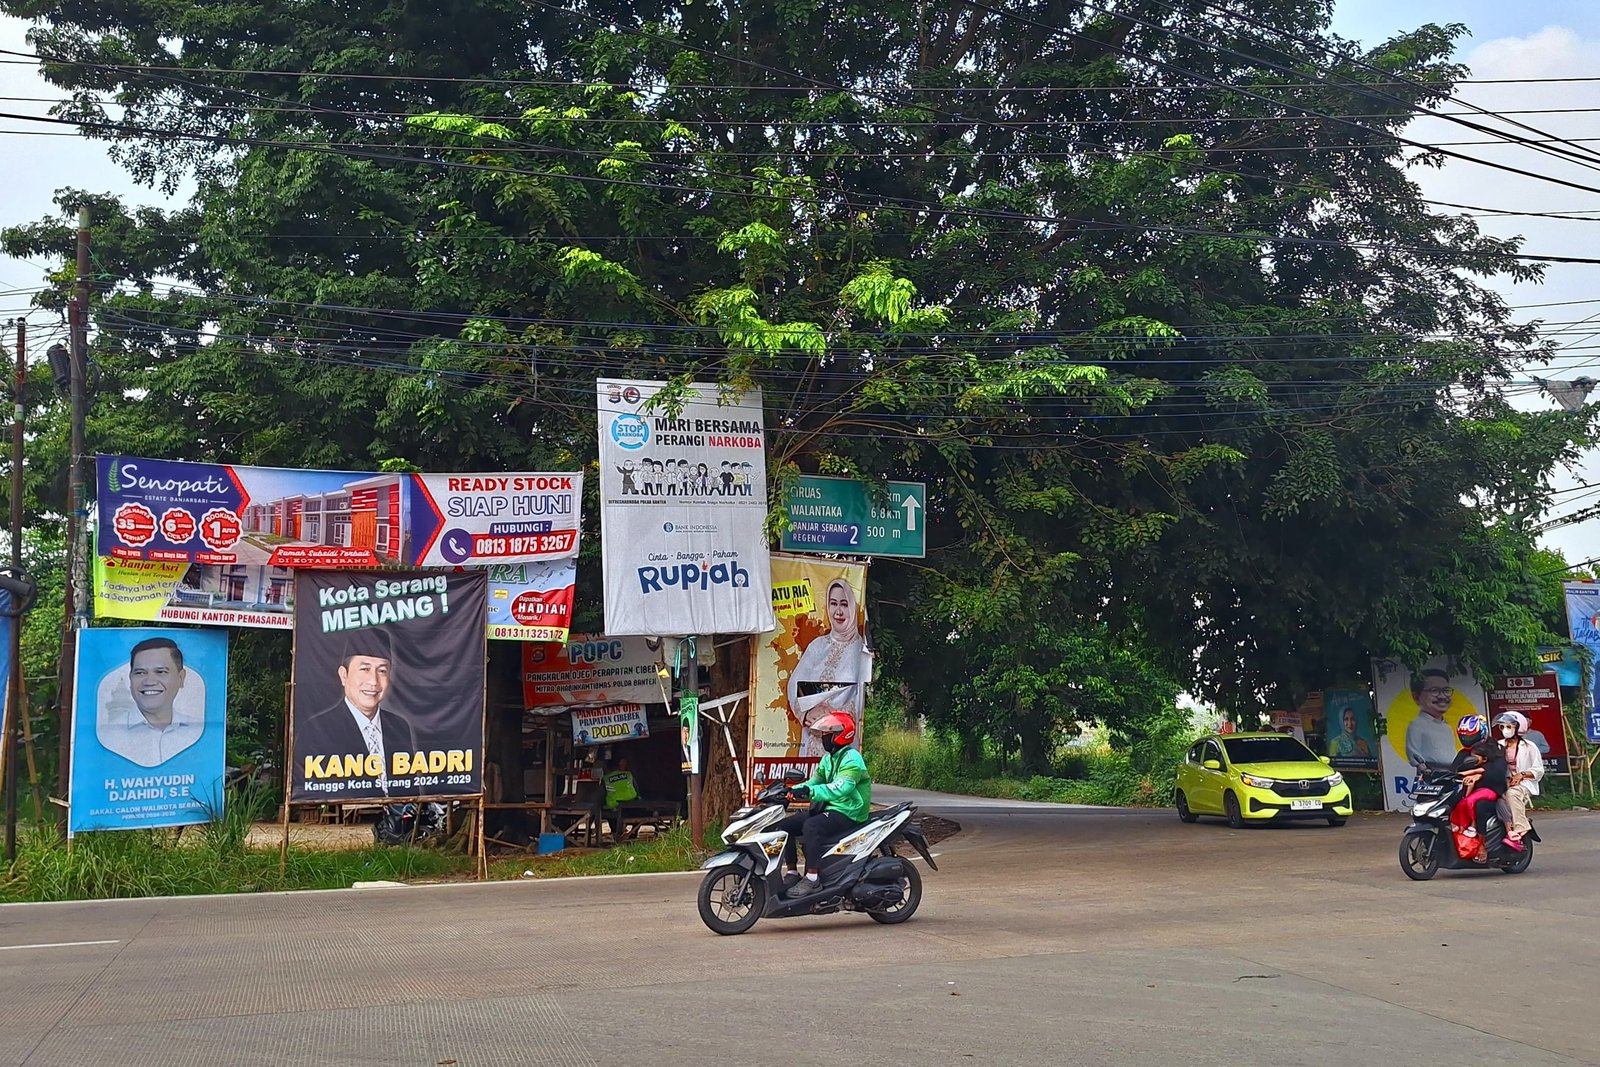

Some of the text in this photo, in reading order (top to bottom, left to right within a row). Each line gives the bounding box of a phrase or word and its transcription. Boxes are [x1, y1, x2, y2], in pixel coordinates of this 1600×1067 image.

[617, 424, 642, 433] STOP
[655, 418, 760, 434] MARI BERSAMA
[656, 435, 762, 448] PERANGI NARKOBA
[121, 464, 229, 496] Senopati
[448, 477, 572, 492] READY STOCK
[448, 494, 572, 517] SIAP HUNI
[791, 505, 842, 517] WALANTAKA
[118, 519, 135, 530] 35
[165, 520, 177, 532] 6
[206, 513, 236, 524] BOOKING
[210, 521, 221, 538] 1
[494, 523, 543, 534] HUBUNGI
[792, 522, 900, 544] BANJAR SERANG 2 500 m
[476, 534, 570, 554] 0813 1875 3267
[793, 533, 826, 543] REGENCY
[648, 550, 738, 562] Cinta Bangga Paham
[120, 560, 180, 572] Banjar Asri
[637, 560, 749, 594] Rupiah
[319, 575, 448, 608] Kota Serang
[792, 584, 809, 598] RIA
[321, 596, 434, 633] MENANG
[518, 602, 566, 615] HADIAH
[161, 609, 200, 620] HUBUNGI
[202, 611, 235, 622] KANTOR
[237, 614, 288, 626] PEMASARAN
[569, 639, 622, 664] POPC
[527, 672, 570, 681] PANGKALAN
[572, 670, 590, 679] OJEG
[593, 668, 633, 678] PERAPATAN
[576, 705, 621, 719] PANGKALAN
[579, 713, 640, 727] PRAPATAN CIBEBEK
[592, 723, 630, 739] POLDA
[304, 749, 473, 778] KANG BADRI
[104, 774, 194, 790] H. WAHYUDIN
[304, 781, 344, 792] Kangge
[348, 779, 372, 789] Kota
[414, 776, 438, 786] 2024
[447, 774, 471, 784] 2029
[109, 786, 189, 802] DJAHIDI, S.E
[142, 804, 177, 812] WALIKOTA
